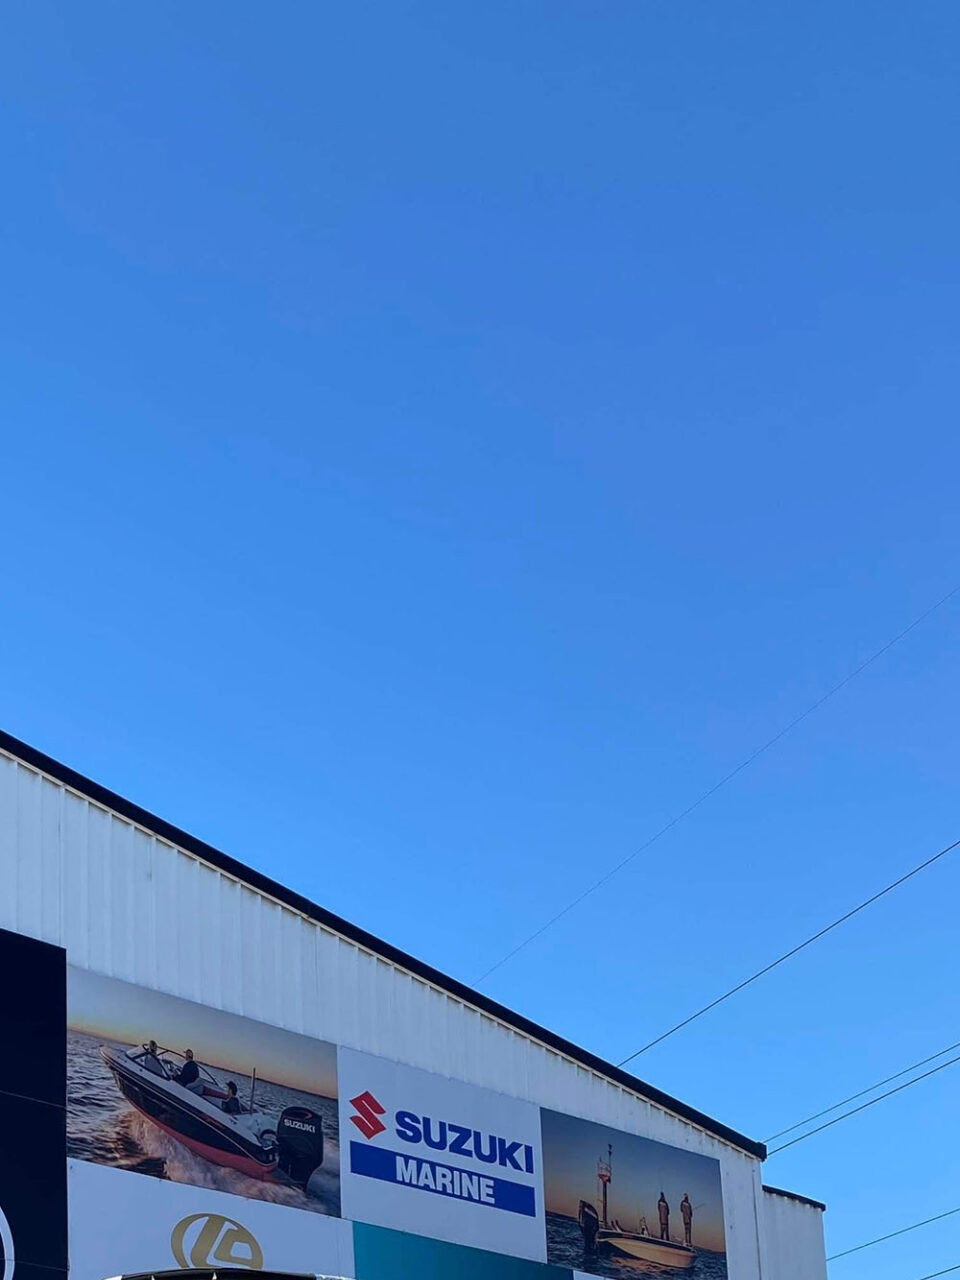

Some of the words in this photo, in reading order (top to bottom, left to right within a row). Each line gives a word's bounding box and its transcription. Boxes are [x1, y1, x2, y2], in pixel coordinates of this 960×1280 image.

[284, 1119, 315, 1133] SUZUKI
[395, 1111, 534, 1174] SUZUKI
[395, 1155, 495, 1204] MARINE
